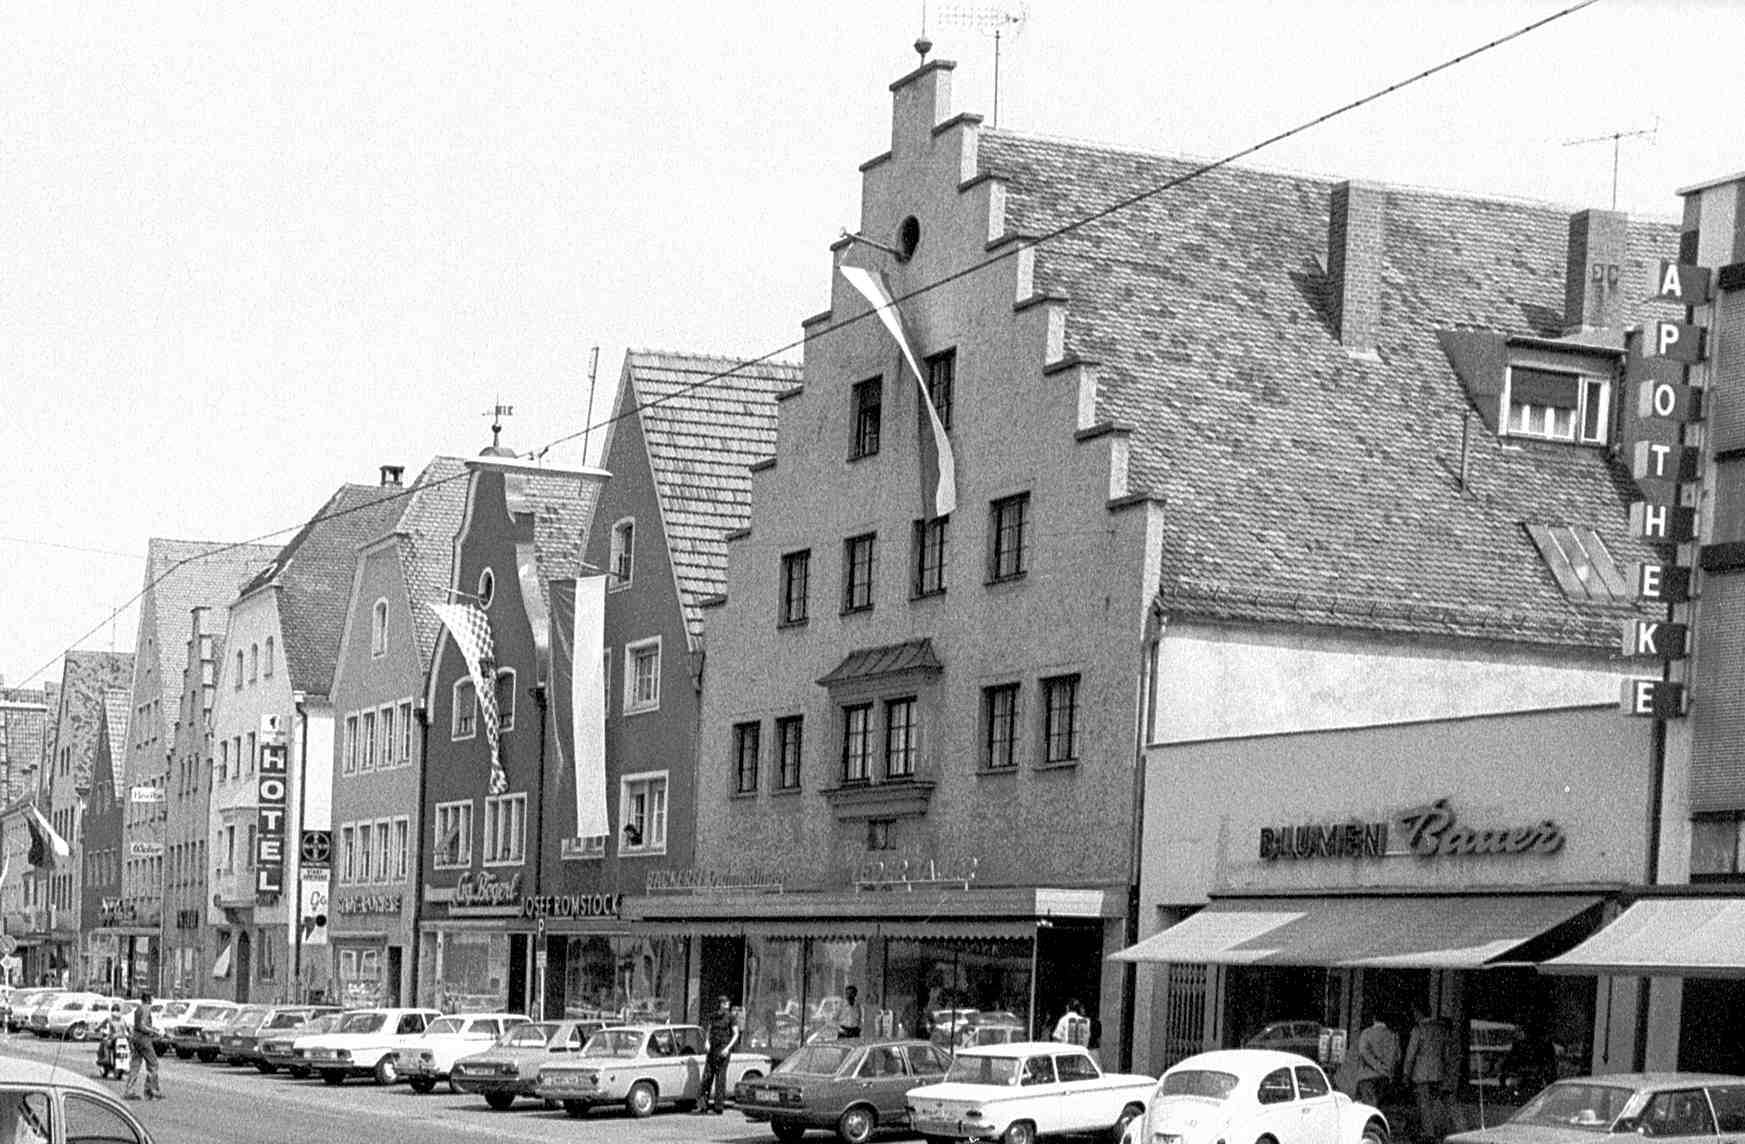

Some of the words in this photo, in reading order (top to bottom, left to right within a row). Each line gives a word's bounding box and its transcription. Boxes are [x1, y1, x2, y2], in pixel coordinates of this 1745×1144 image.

[1636, 264, 1682, 713] APOTHEKE
[258, 748, 286, 892] HOTEL
[1259, 823, 1389, 859] BLUMEN
[1402, 799, 1566, 857] Bauer
[520, 896, 551, 919] JOSEF
